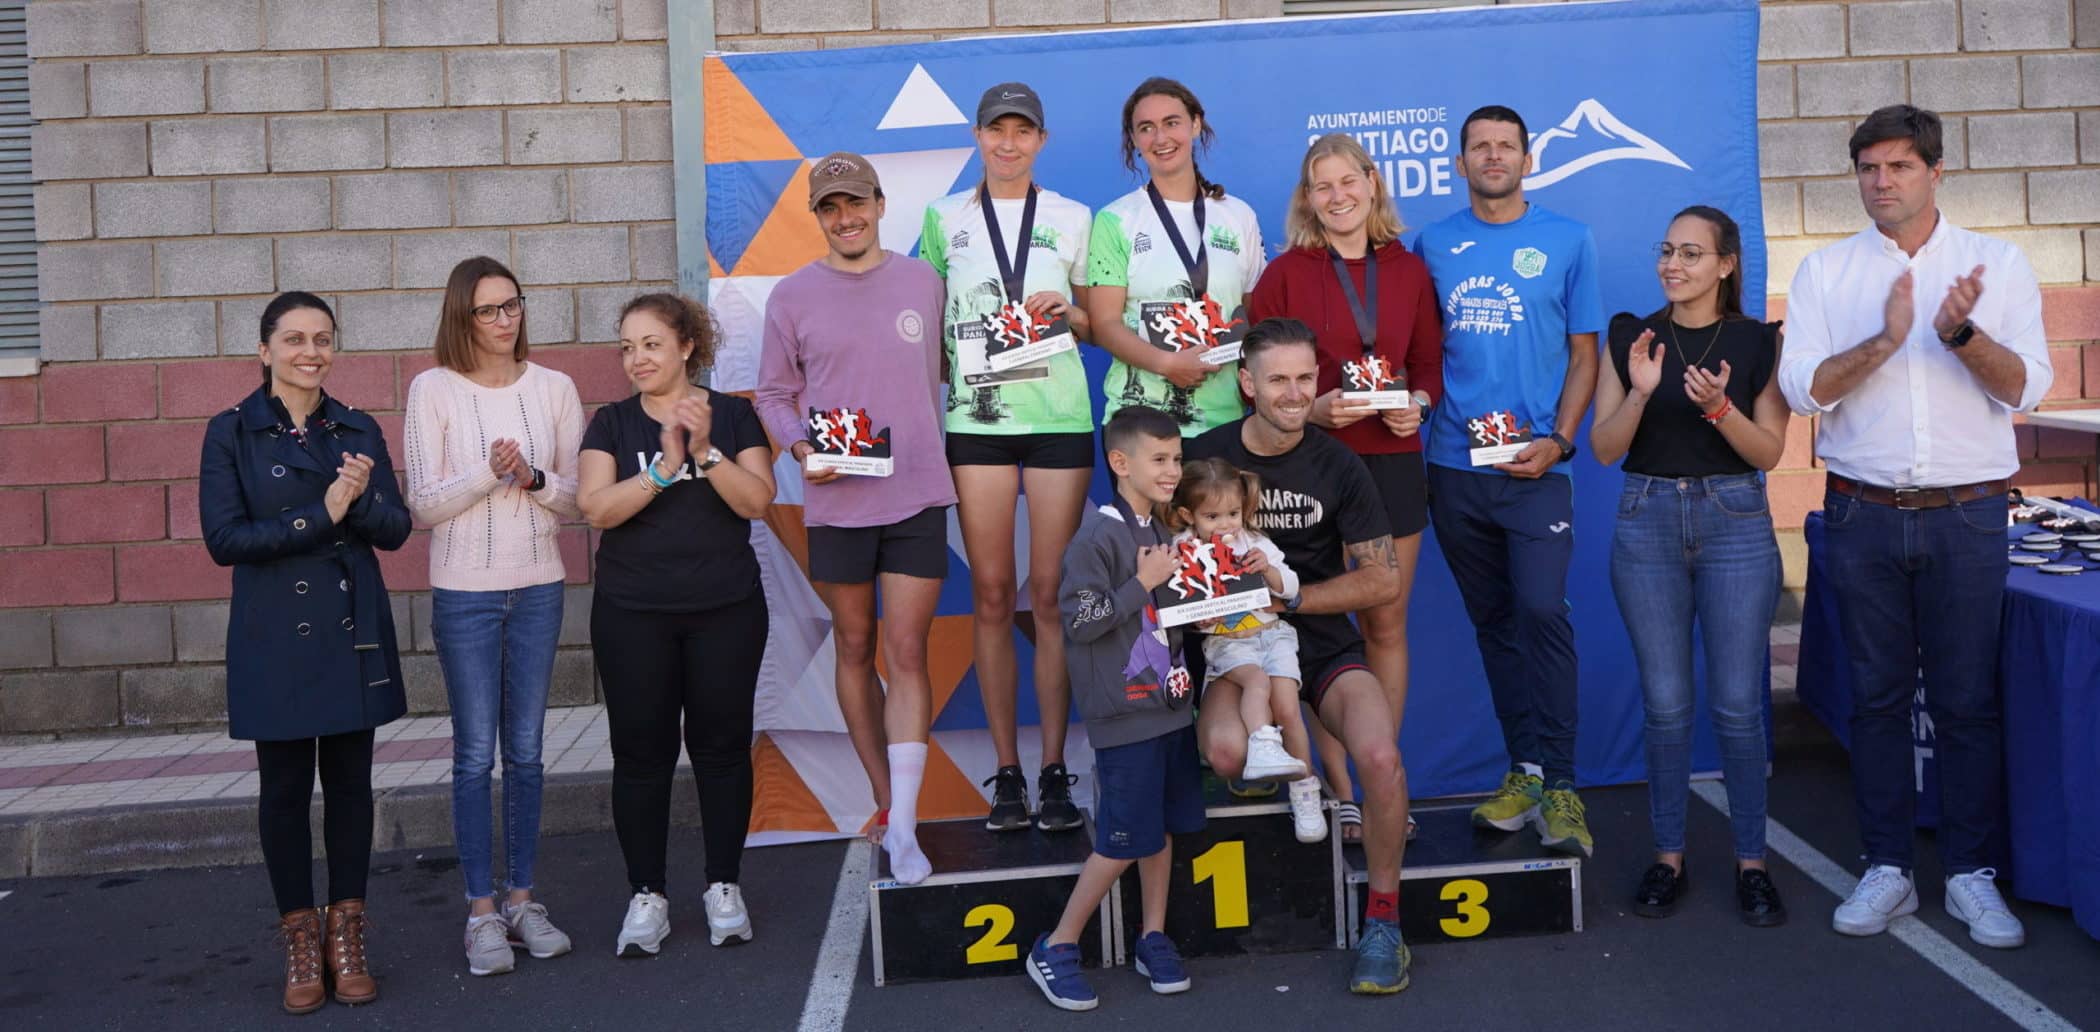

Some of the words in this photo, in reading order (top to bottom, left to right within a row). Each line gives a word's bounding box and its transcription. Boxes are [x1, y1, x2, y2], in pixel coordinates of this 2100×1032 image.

[1308, 127, 1449, 156] TIAGO
[1375, 157, 1452, 198] IDE
[1446, 275, 1495, 316] PINTURAS
[1496, 282, 1524, 322] JORBA
[1252, 512, 1302, 529] UNNER
[1258, 488, 1304, 511] NARY
[1192, 840, 1249, 929] 1
[1439, 879, 1492, 938] 3
[963, 904, 1018, 965] 2
